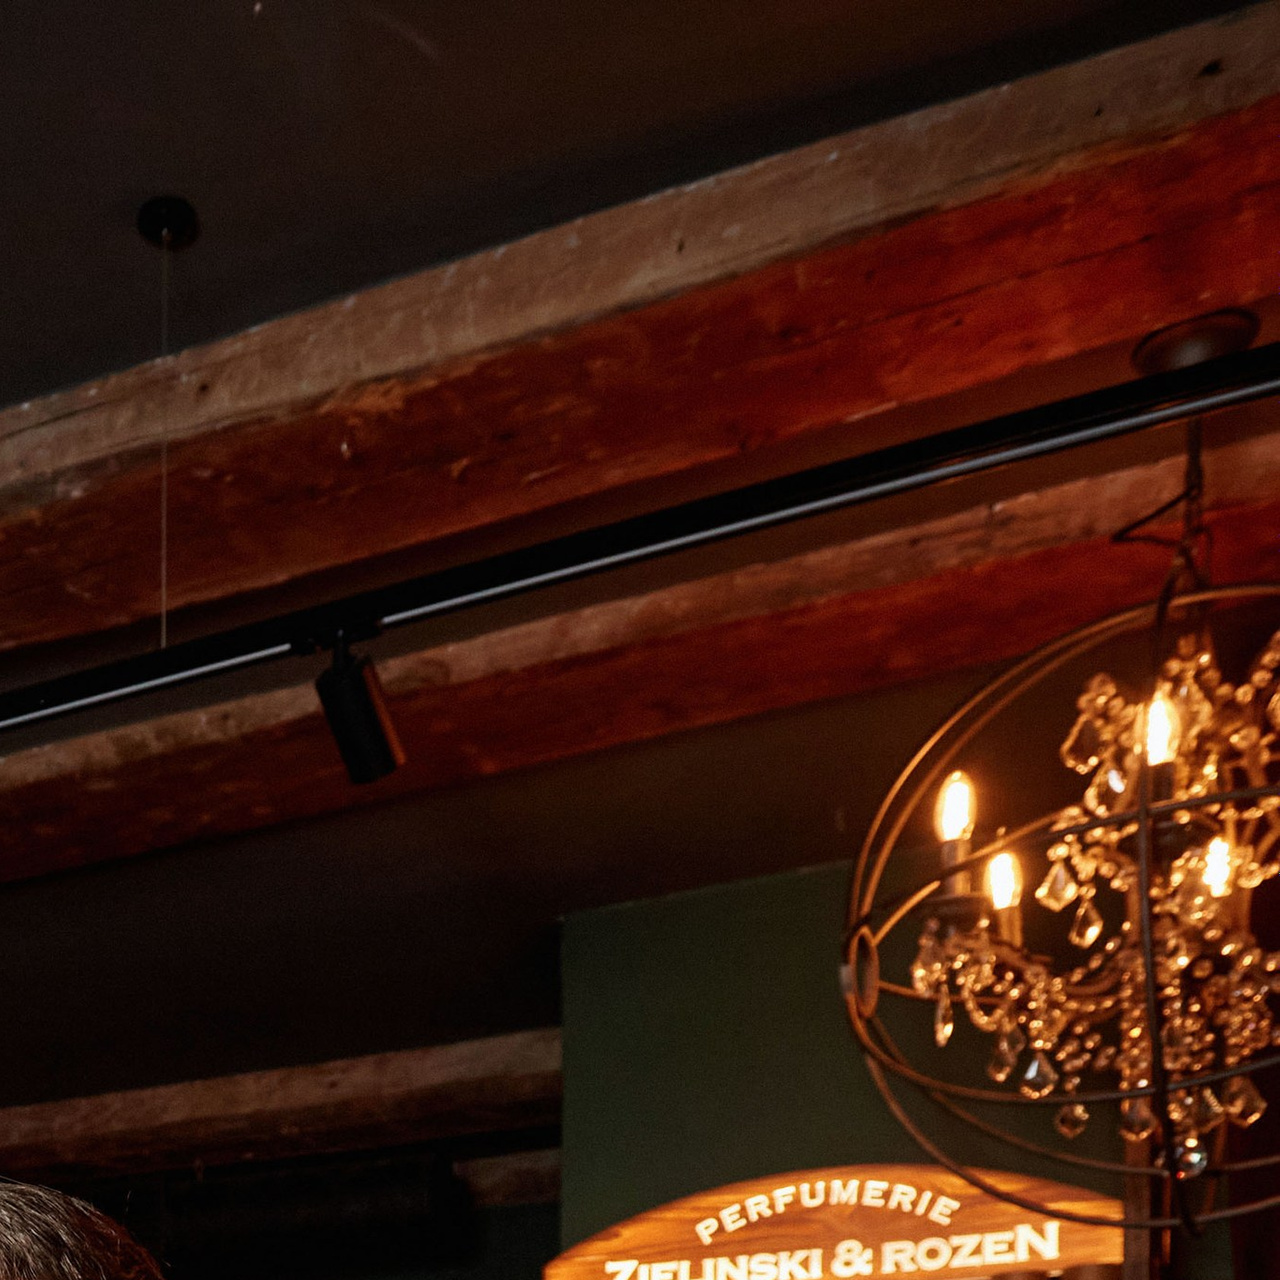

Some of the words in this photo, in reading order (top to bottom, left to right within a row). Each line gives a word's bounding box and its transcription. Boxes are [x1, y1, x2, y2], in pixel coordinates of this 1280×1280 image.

[695, 1179, 961, 1245] PERFUMERIE
[830, 1239, 874, 1277] &
[880, 1221, 1061, 1274] ROZEN
